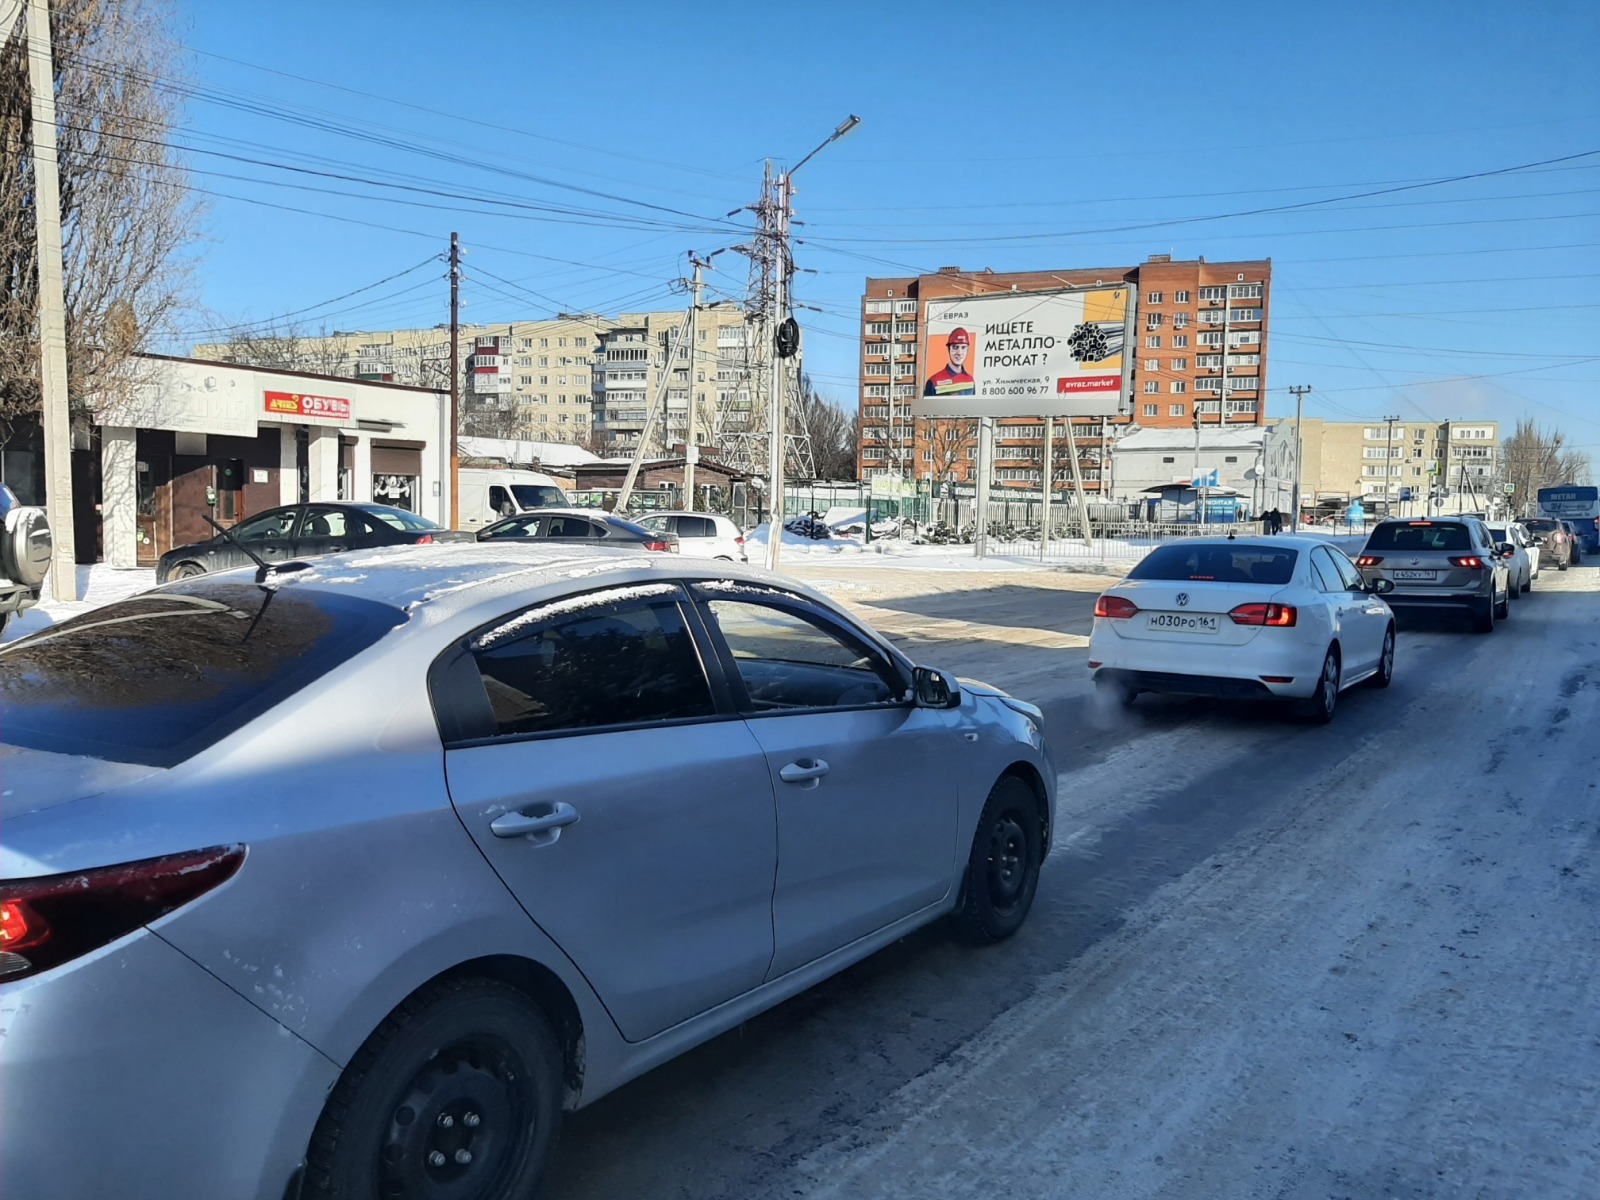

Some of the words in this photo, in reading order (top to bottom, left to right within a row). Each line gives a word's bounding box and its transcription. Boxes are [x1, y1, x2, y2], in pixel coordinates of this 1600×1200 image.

[986, 321, 1034, 336] ИЩЕТЕ
[984, 336, 1062, 352] МЕТАЛЛО-
[984, 354, 1038, 368] ПРОКАТ
[982, 388, 987, 396] 8
[990, 387, 1006, 395] 800
[1008, 386, 1024, 394] 600
[1026, 386, 1038, 394] 96
[1040, 386, 1048, 394] 77
[1066, 380, 1114, 388] evraz.market
[302, 396, 349, 412] ОБУВЬ
